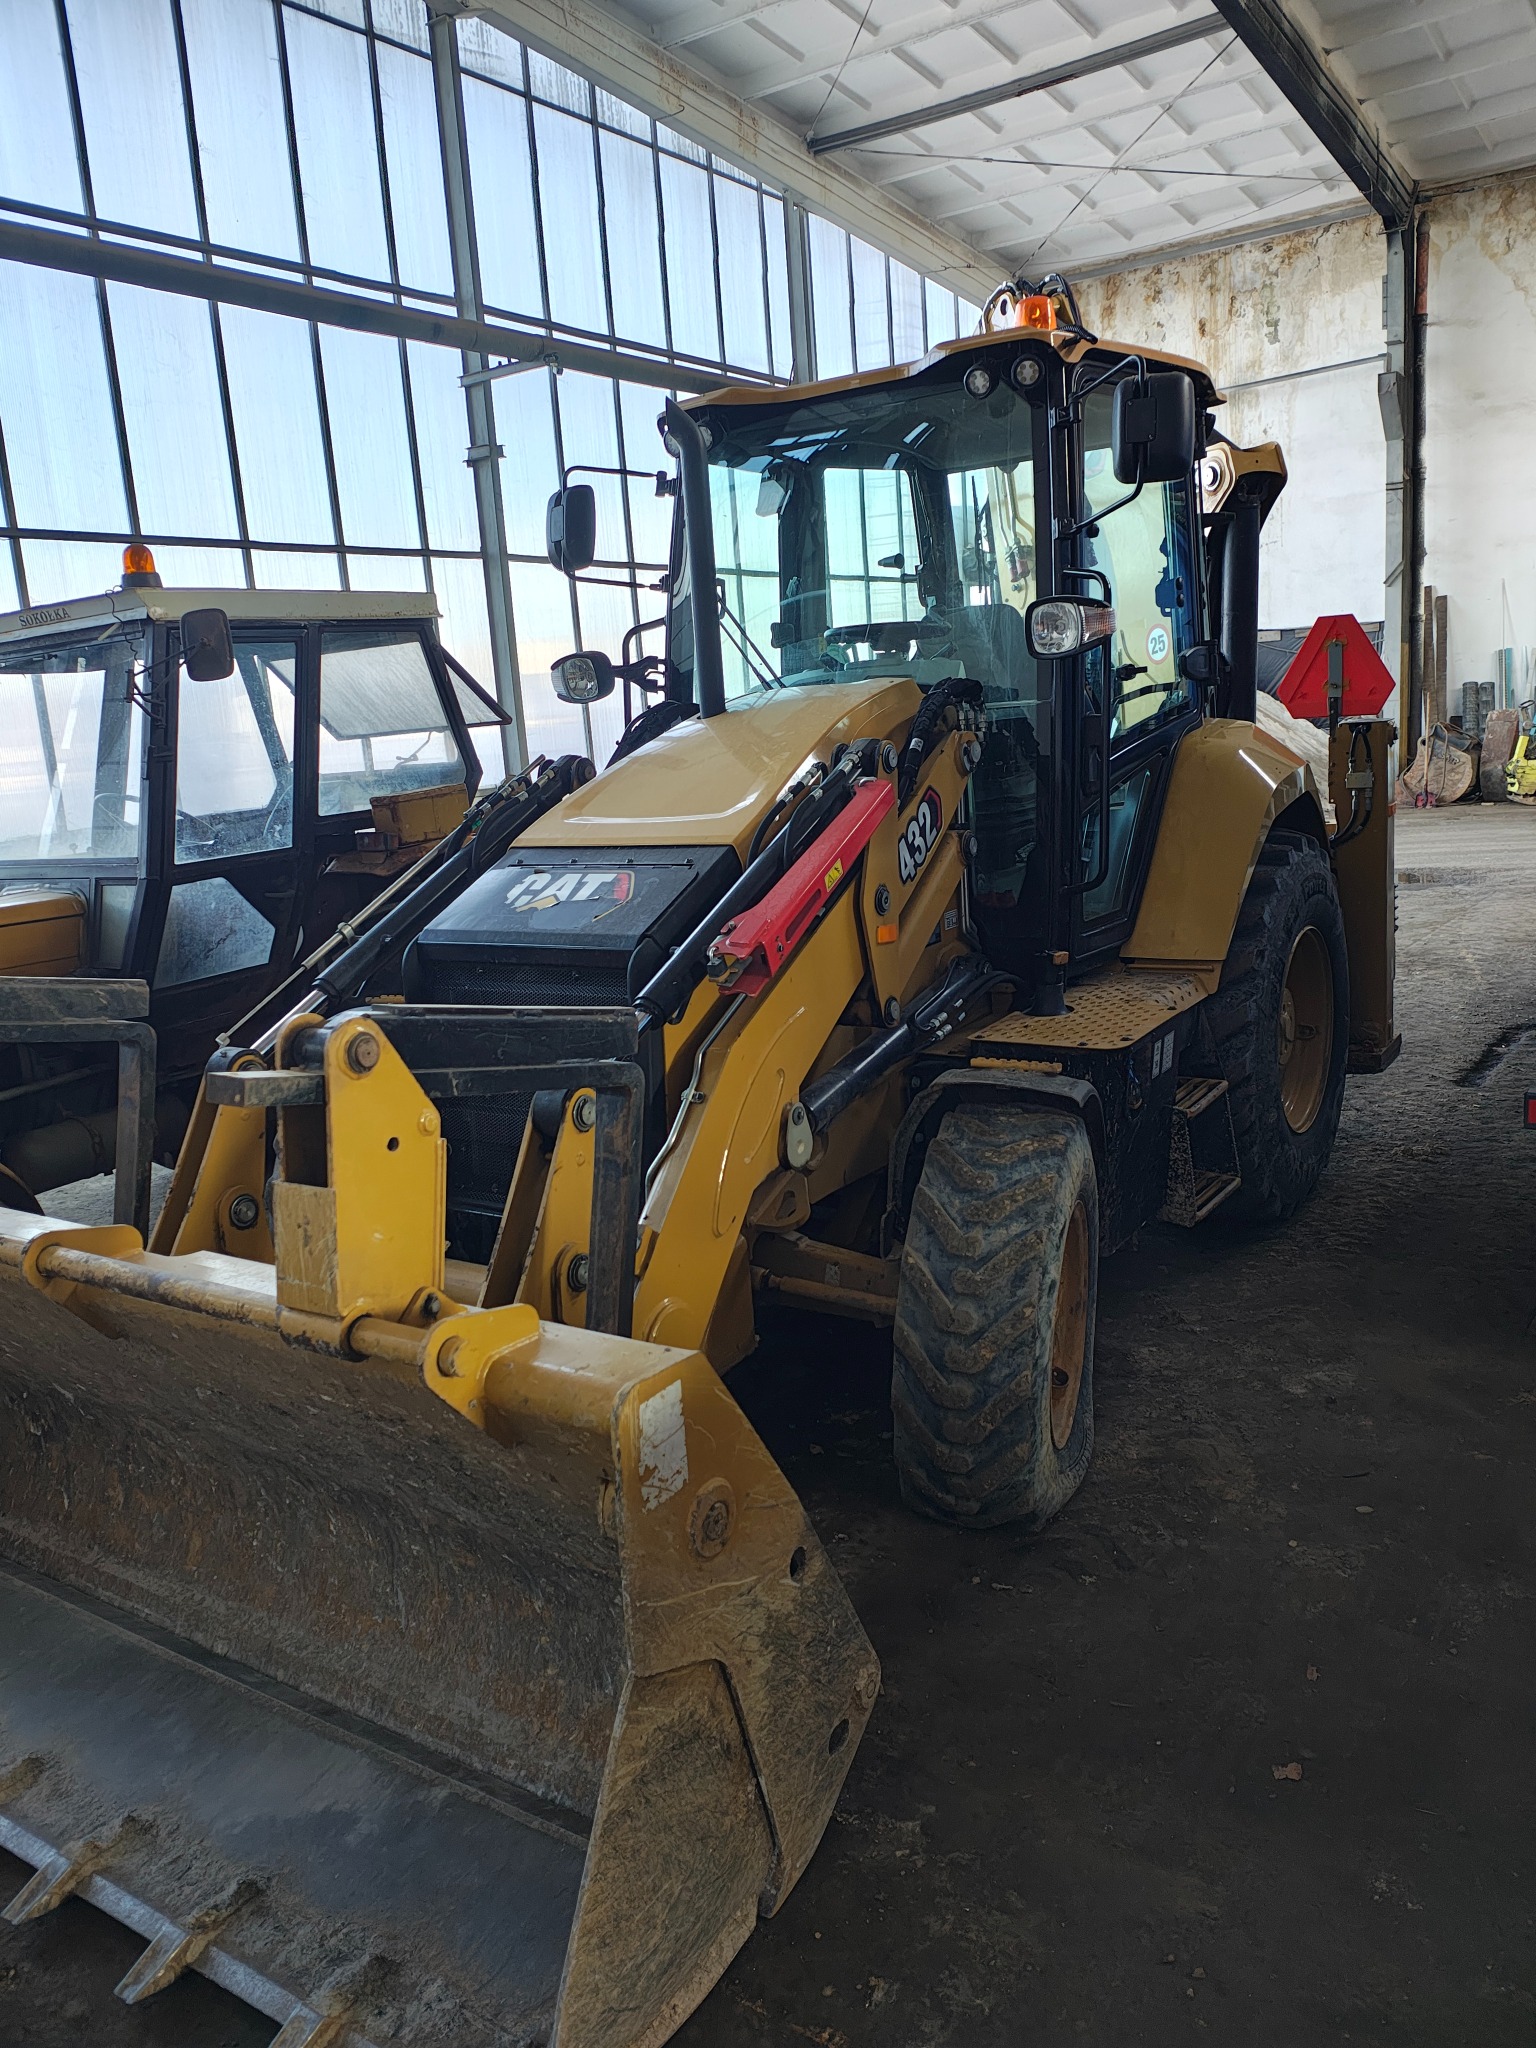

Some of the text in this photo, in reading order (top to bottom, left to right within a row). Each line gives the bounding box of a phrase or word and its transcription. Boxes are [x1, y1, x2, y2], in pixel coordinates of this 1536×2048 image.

[1150, 633, 1166, 655] 25
[899, 801, 937, 881] 432
[504, 873, 618, 909] CAT
